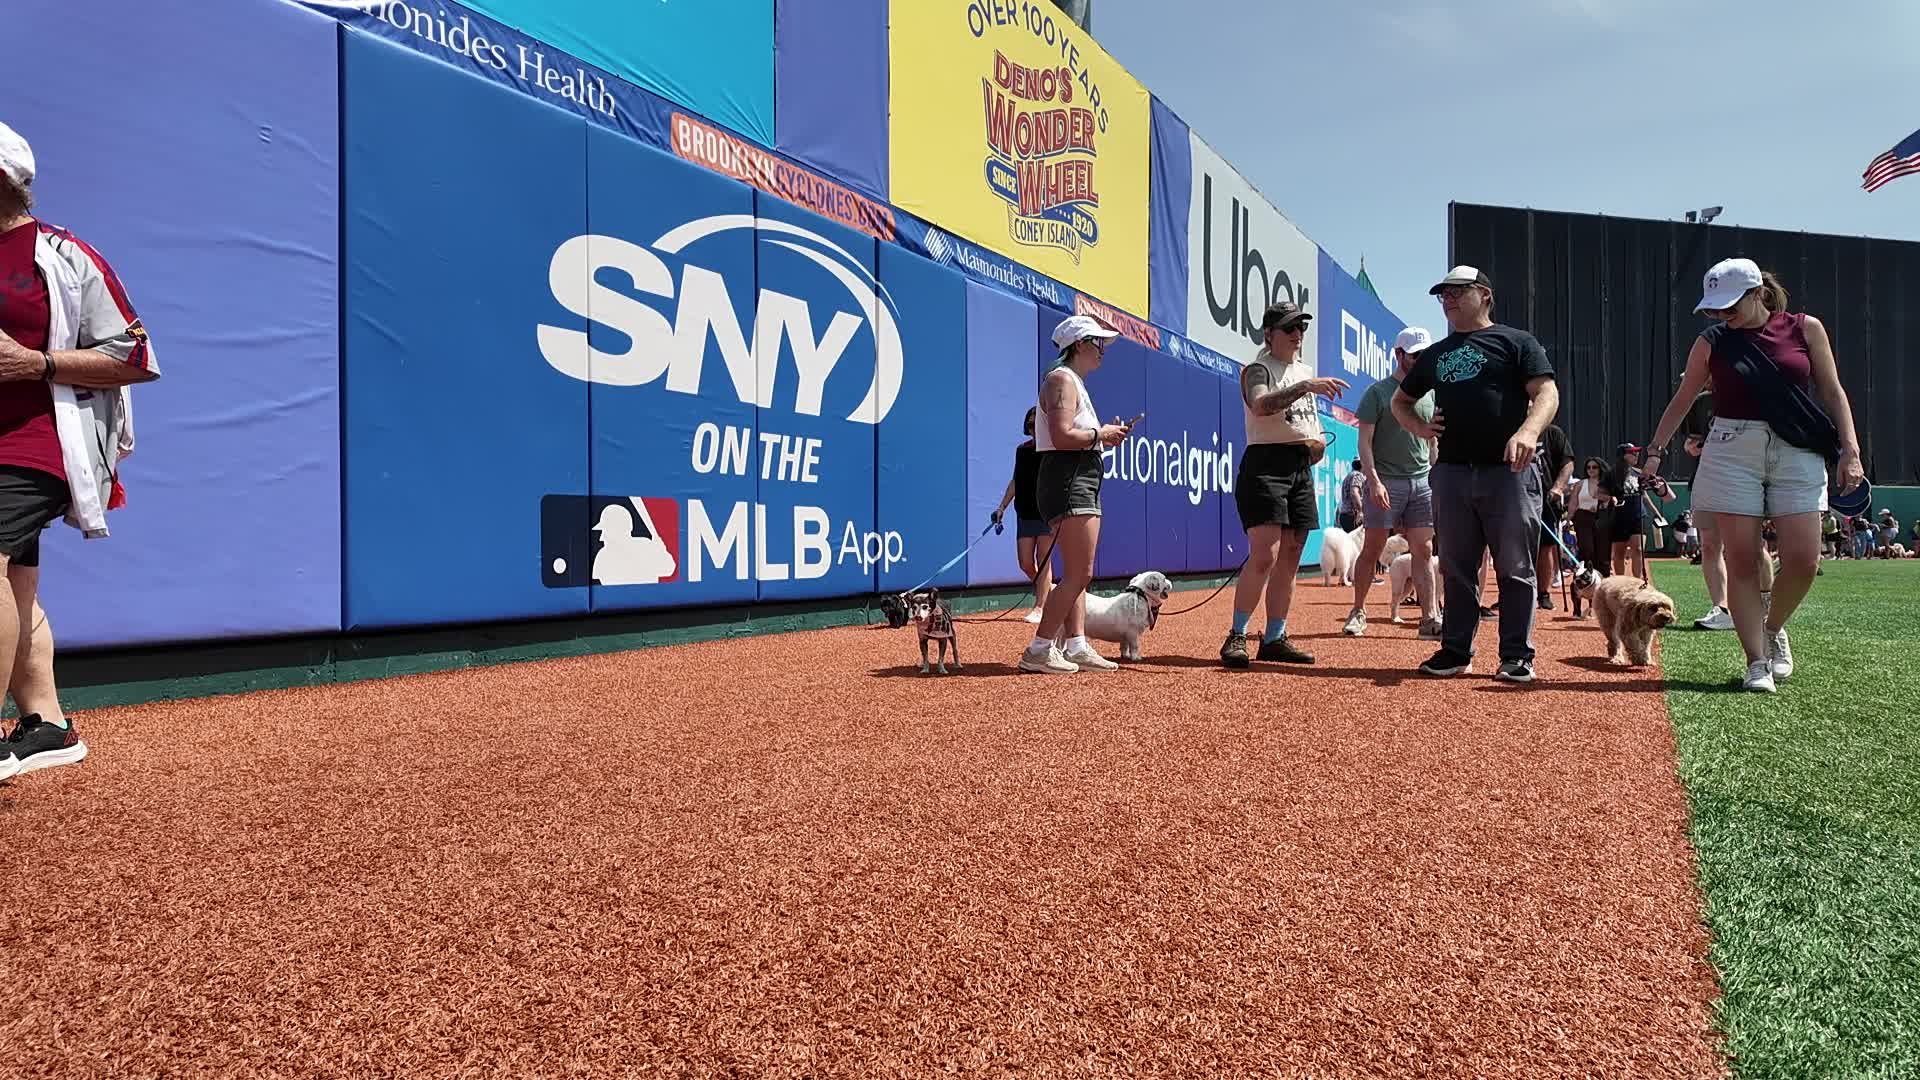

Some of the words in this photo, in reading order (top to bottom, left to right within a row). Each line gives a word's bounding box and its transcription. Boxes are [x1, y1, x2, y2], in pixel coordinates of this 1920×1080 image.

[517, 44, 616, 118] Health
[968, 0, 1019, 38] OVER
[1022, 1, 1055, 46] 100
[1058, 28, 1109, 133] YEARS
[994, 48, 1072, 104] DENO'S
[982, 76, 1096, 161] WONDER
[1015, 159, 1099, 218] WHEEL
[1014, 218, 1044, 242] CONEY
[1047, 223, 1077, 251] ISLAND
[1072, 211, 1094, 238] 1920
[956, 243, 1024, 290] Maimonides
[537, 234, 864, 417] SNY
[691, 421, 751, 476] ON
[759, 432, 823, 483] THE
[1101, 420, 1233, 505] ationalgrid
[687, 499, 832, 583] MLB
